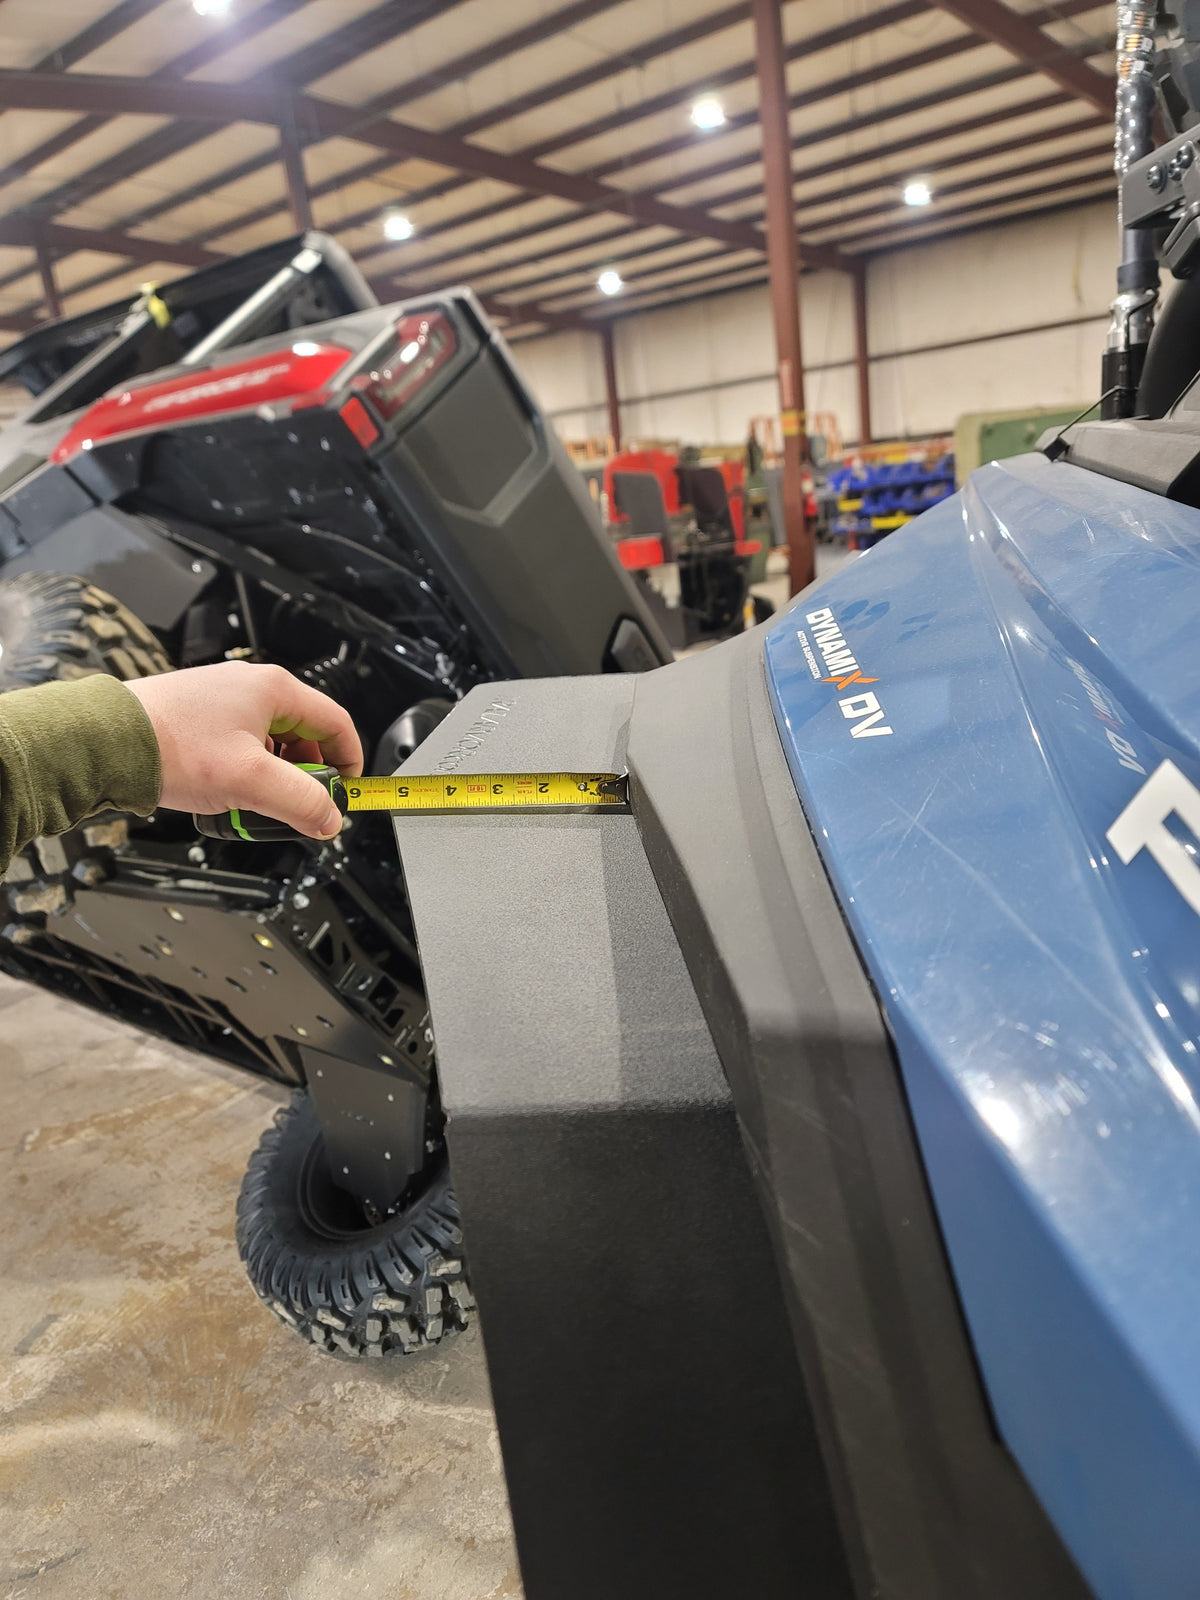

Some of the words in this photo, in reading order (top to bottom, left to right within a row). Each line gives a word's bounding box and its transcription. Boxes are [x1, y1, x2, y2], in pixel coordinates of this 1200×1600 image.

[805, 606, 881, 691] DYNAMIX
[802, 646, 822, 680] SUSPENSION
[838, 690, 894, 739] DV
[349, 787, 362, 798] 6
[398, 786, 409, 798] 5
[445, 784, 458, 796] 4
[492, 783, 504, 795] 3
[538, 782, 550, 794] 2
